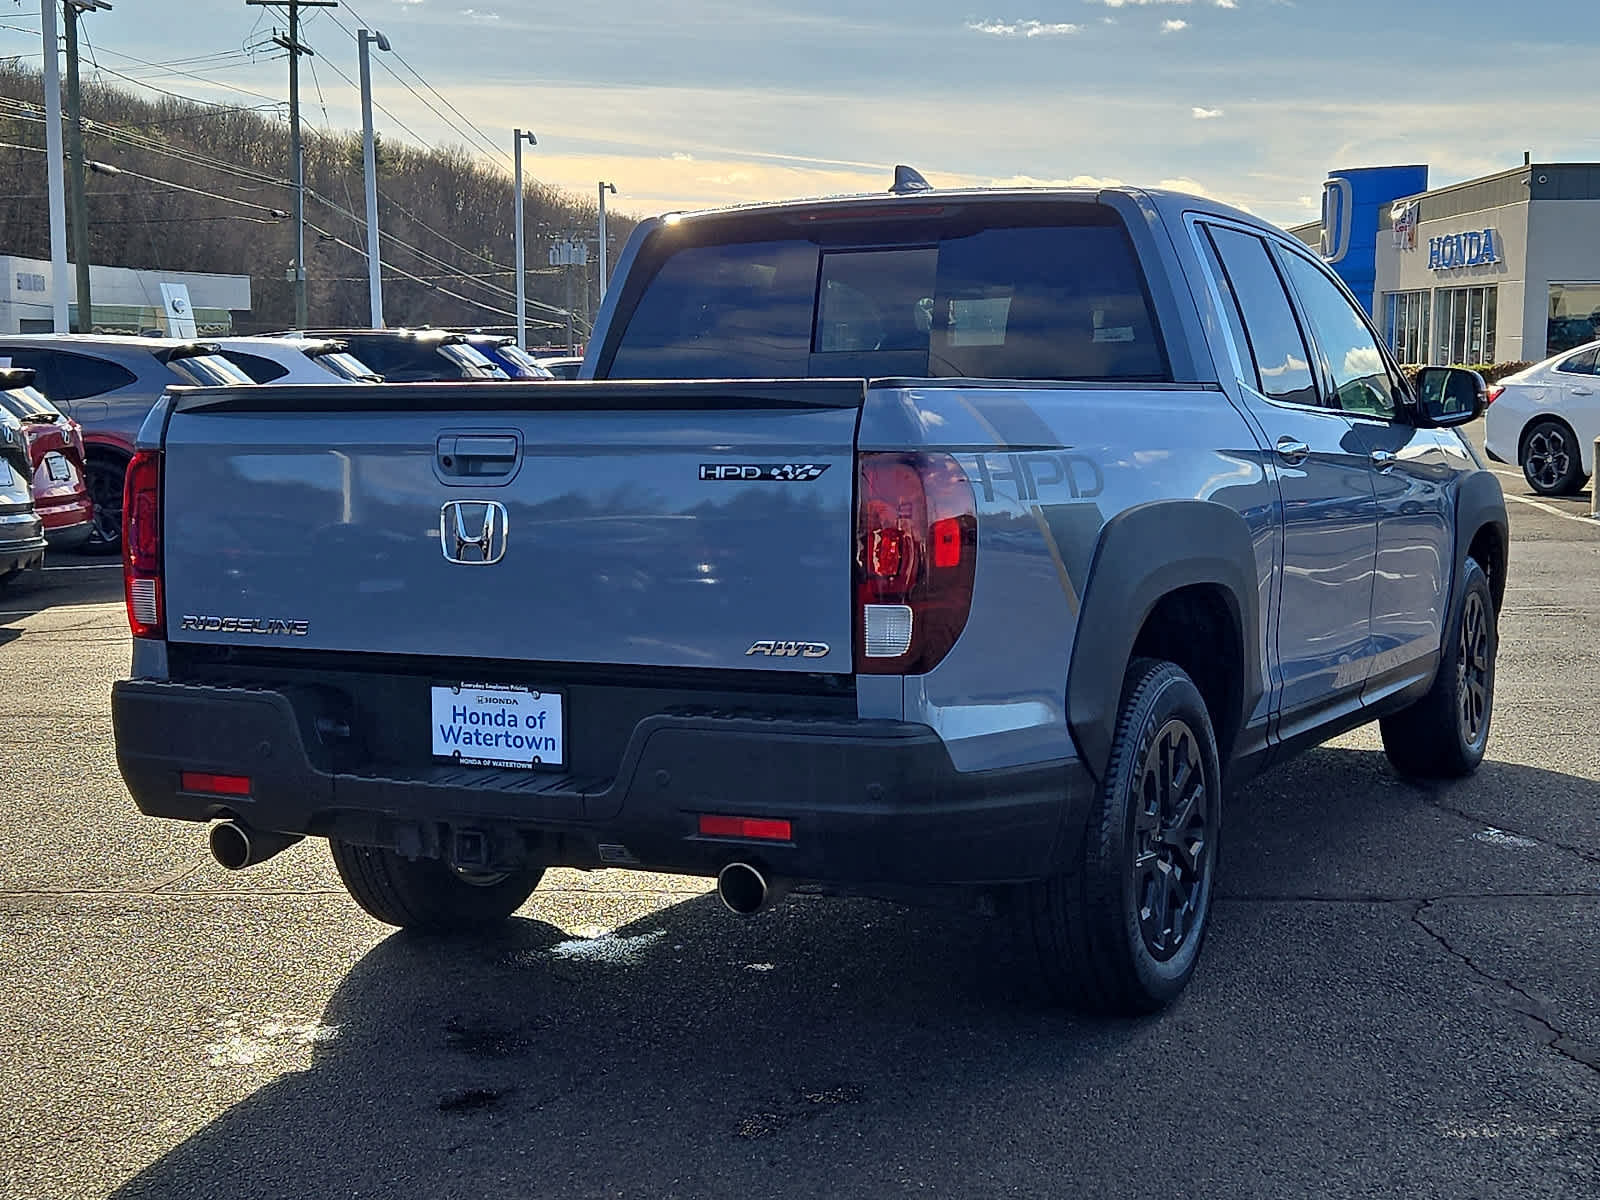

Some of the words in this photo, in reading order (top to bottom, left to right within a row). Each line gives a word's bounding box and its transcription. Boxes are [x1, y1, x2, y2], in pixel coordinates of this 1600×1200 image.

[1428, 228, 1496, 270] HONDA
[700, 465, 761, 479] HPD
[975, 454, 1104, 502] HPD
[180, 614, 309, 635] RIDGELINE
[745, 640, 830, 657] AWD
[485, 697, 519, 705] HONDA
[452, 704, 518, 728] Honda
[525, 711, 547, 730] of
[440, 724, 556, 752] Watertown
[459, 758, 482, 766] HONDA
[491, 761, 533, 769] WATERTOWN
